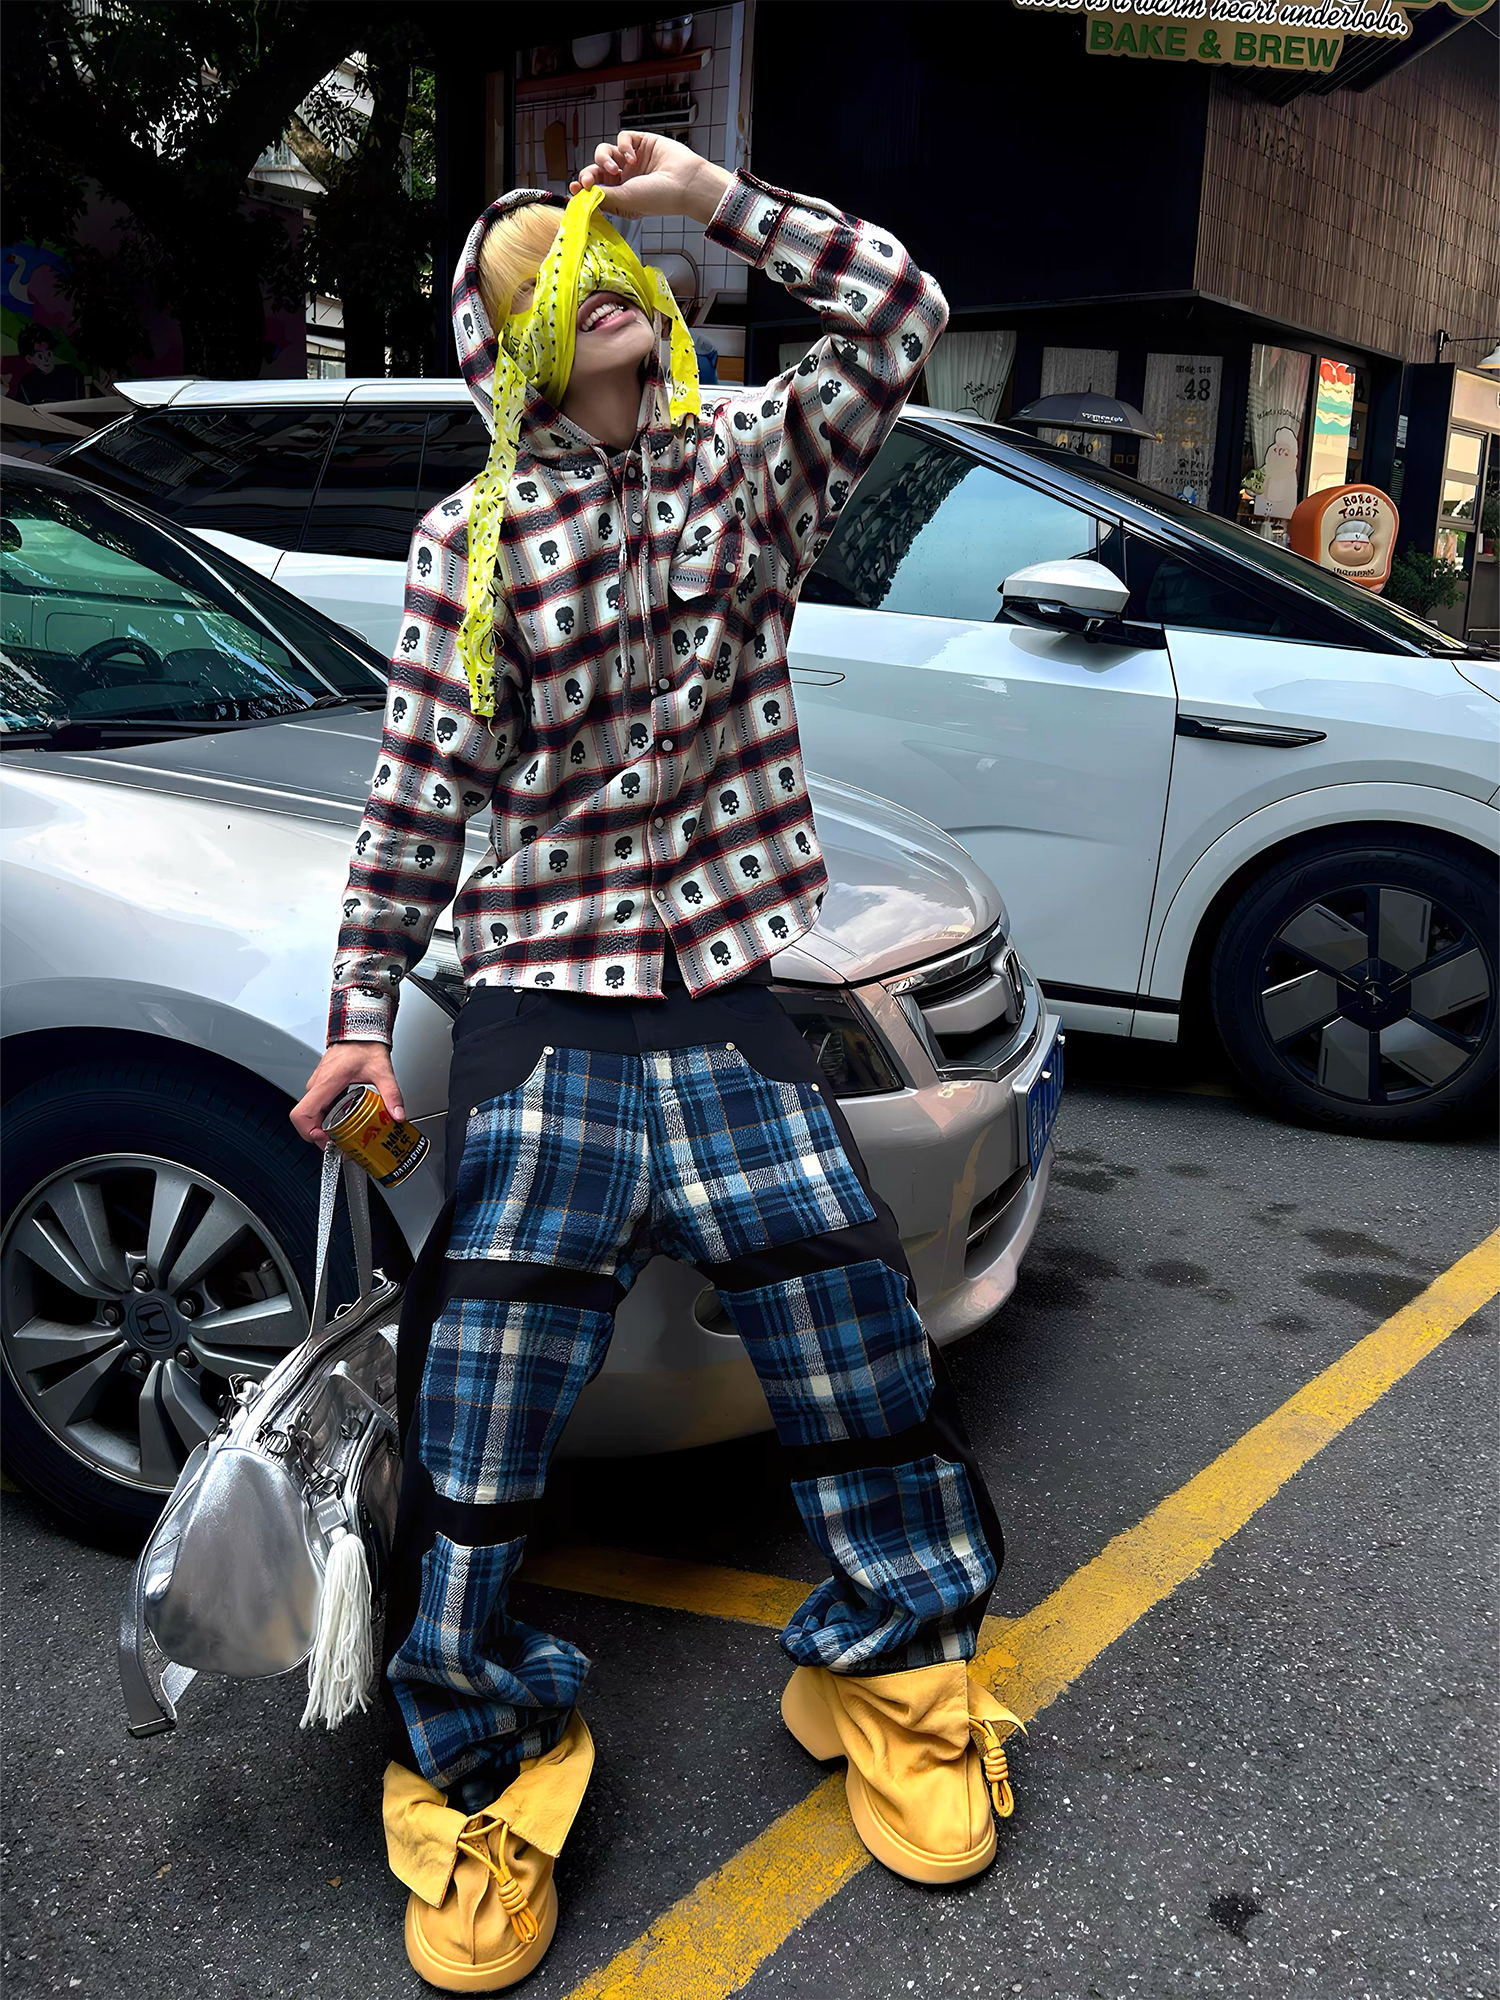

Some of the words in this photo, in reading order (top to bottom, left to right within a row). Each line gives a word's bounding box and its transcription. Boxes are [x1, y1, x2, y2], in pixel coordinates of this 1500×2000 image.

[1135, 0, 1206, 17] warm
[1210, 0, 1277, 21] heart
[1090, 19, 1188, 57] BAKE
[1197, 28, 1222, 59] &
[1233, 31, 1340, 68] BREW
[1183, 377, 1211, 401] 48
[1338, 505, 1380, 519] TOAST
